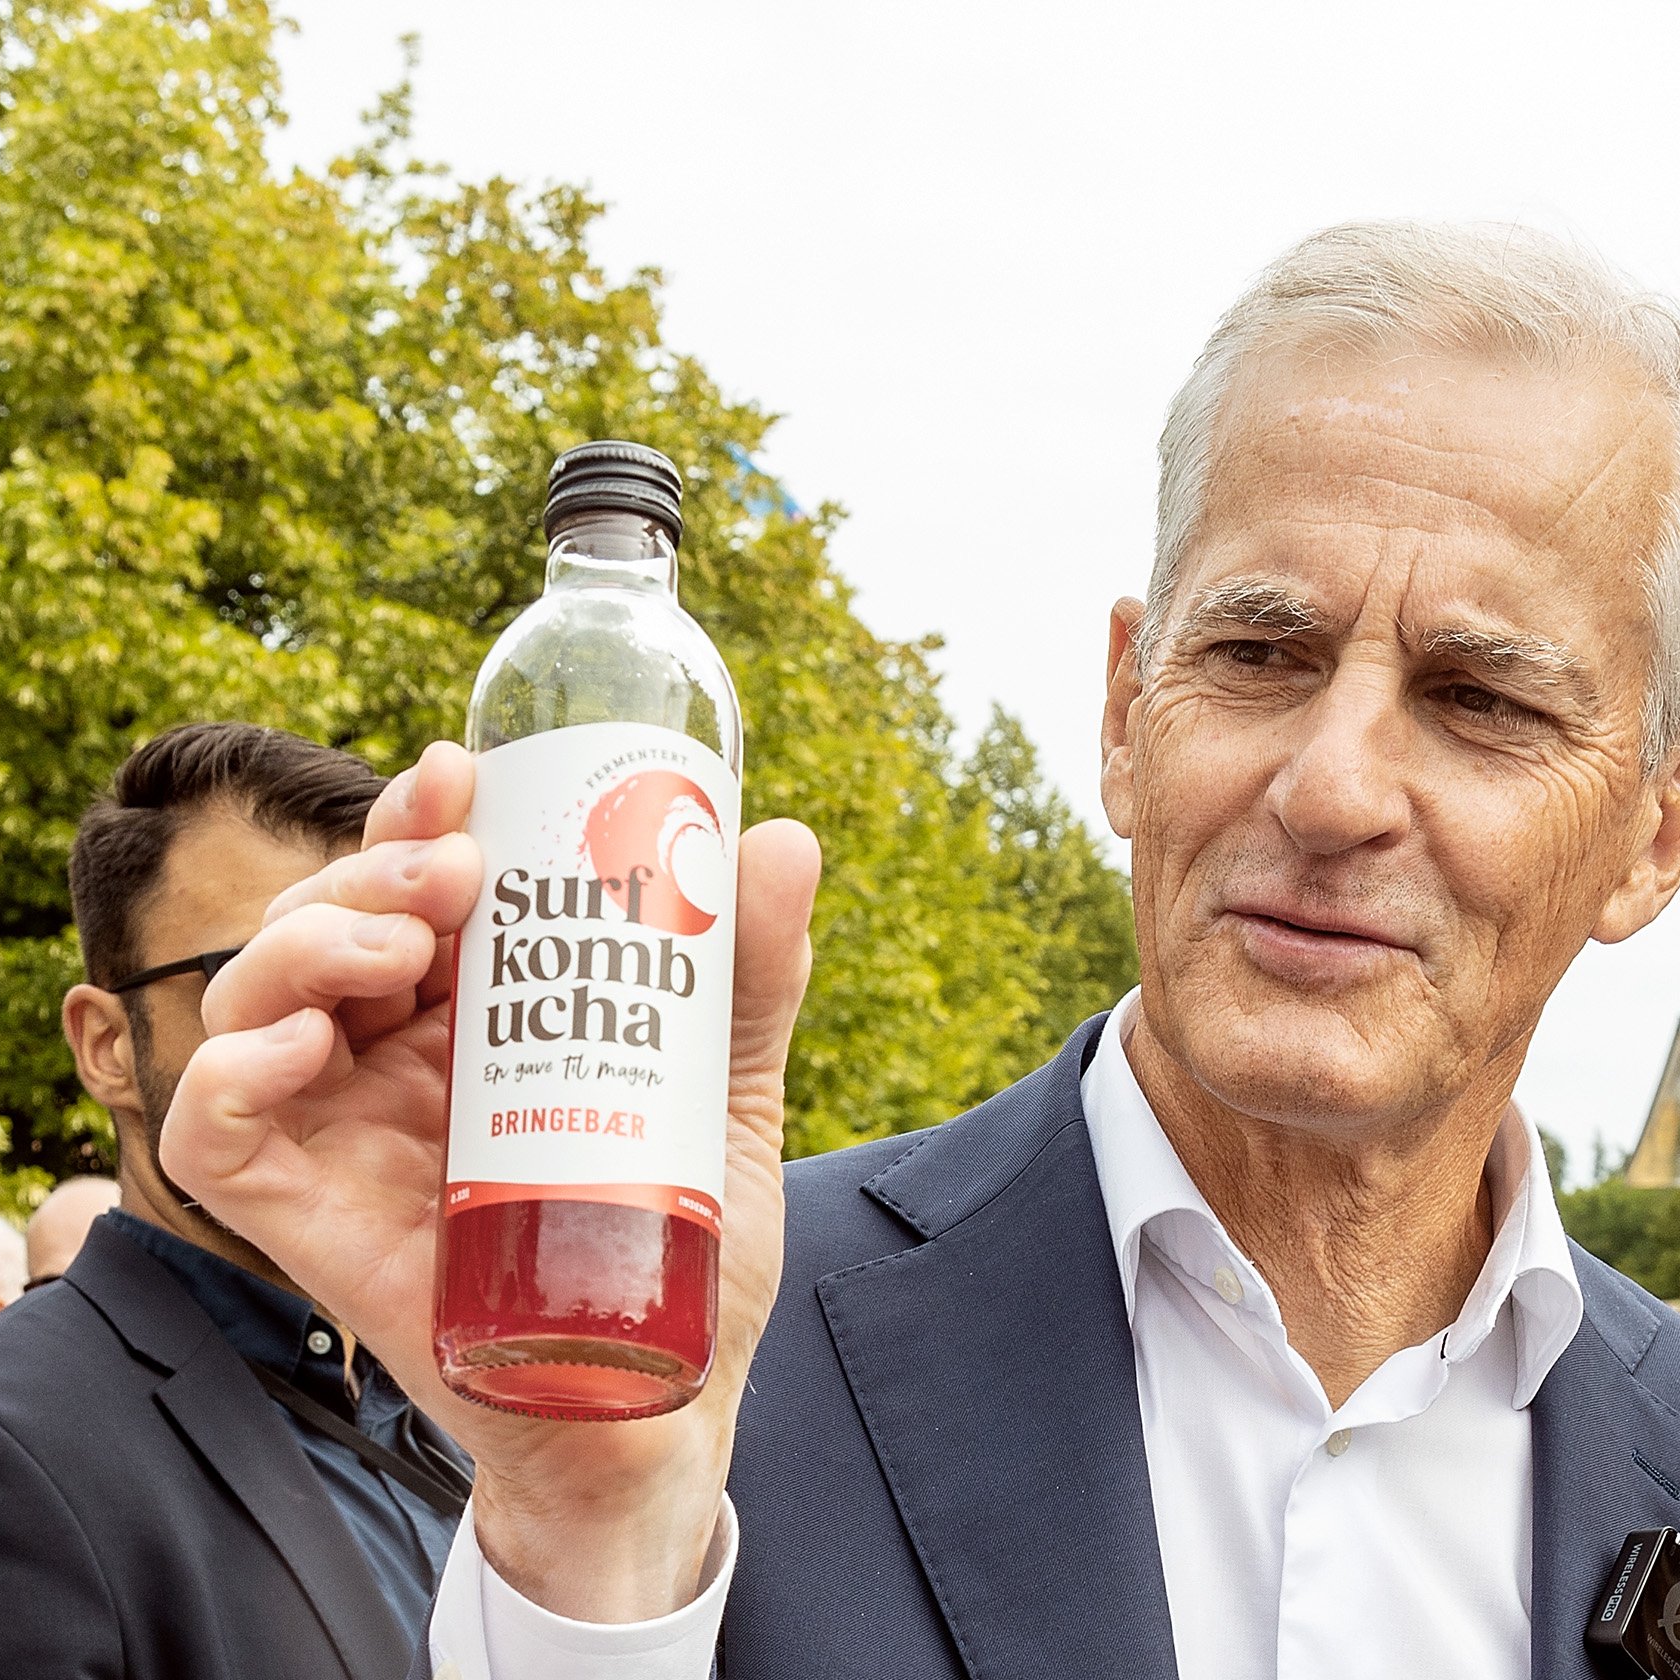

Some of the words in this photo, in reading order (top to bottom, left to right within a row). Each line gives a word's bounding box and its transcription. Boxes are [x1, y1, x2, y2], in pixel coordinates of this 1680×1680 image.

[584, 748, 687, 789] FERMENTERT
[492, 864, 654, 926] Surf
[490, 931, 695, 998] komb
[486, 985, 662, 1052] ucha
[484, 1062, 509, 1085] En
[515, 1060, 553, 1082] gave
[596, 1060, 664, 1087] magen
[491, 1106, 645, 1140] BRINGEBÆR
[1614, 1542, 1643, 1594] WIRELESS
[1601, 1594, 1622, 1621] PRO
[1646, 1633, 1674, 1667] WIRELESS
